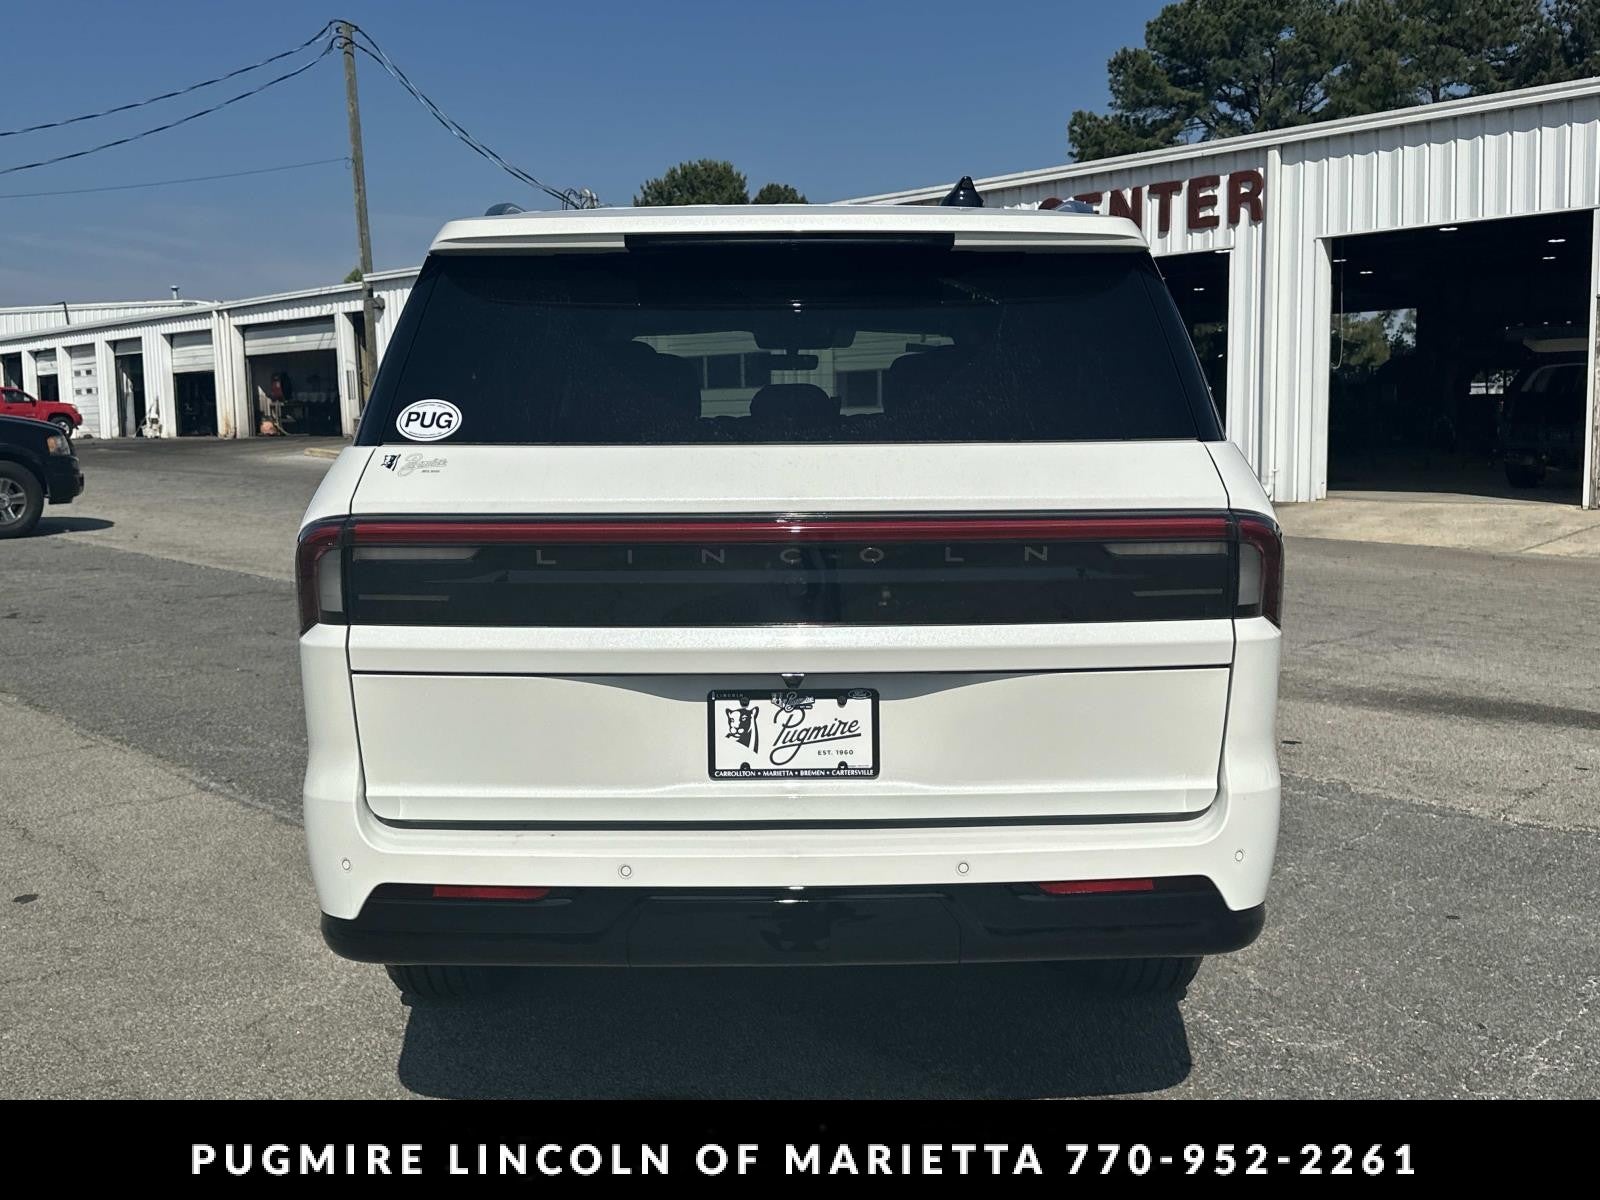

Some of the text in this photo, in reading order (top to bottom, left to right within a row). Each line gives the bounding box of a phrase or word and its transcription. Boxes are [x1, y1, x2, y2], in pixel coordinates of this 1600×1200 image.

[1038, 169, 1264, 232] NTER
[404, 411, 454, 429] PUG
[535, 546, 1049, 565] LINCOLN
[769, 706, 862, 765] Pugmire
